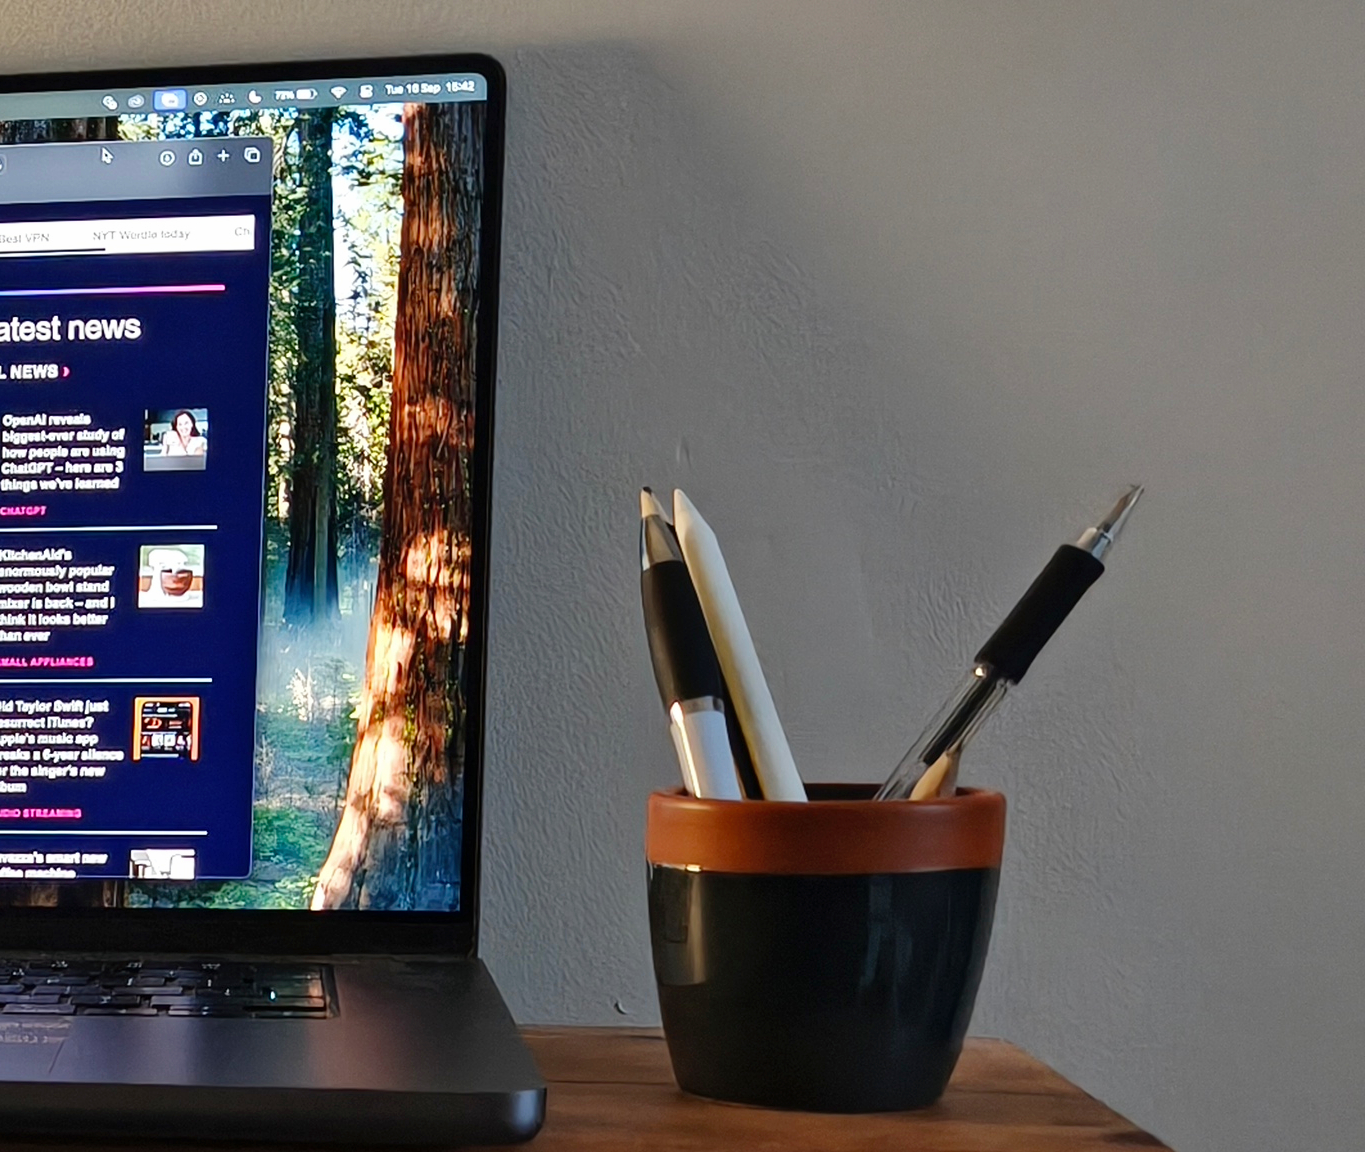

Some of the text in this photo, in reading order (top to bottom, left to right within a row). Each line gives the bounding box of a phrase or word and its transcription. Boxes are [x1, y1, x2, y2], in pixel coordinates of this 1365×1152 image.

[385, 84, 404, 95] Tue
[68, 317, 142, 341] news
[10, 364, 58, 379] NEWS
[2, 414, 47, 427] OpenAI
[76, 428, 110, 442] study
[112, 428, 125, 440] of
[2, 446, 27, 458] how
[1, 462, 53, 475] ChatGPT
